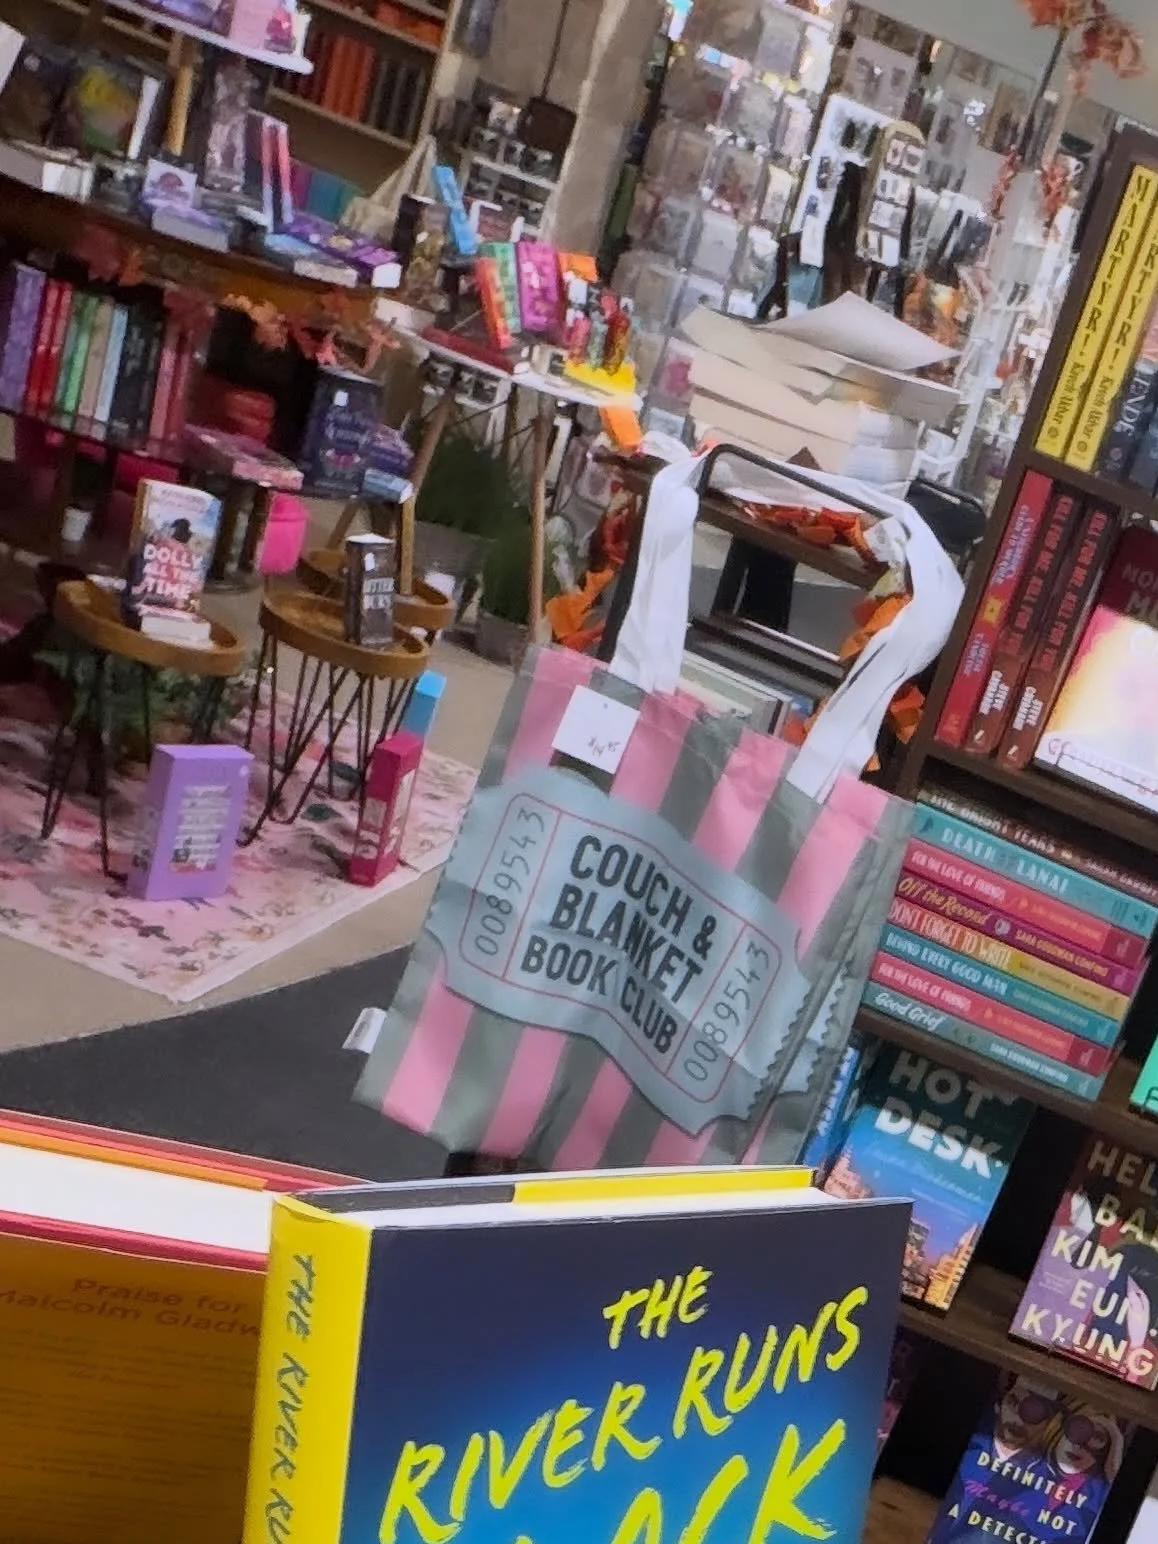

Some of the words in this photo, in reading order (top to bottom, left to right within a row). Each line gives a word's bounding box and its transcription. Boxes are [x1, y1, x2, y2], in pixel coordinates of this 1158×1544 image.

[1076, 176, 1151, 358] MARTYR!
[142, 542, 203, 569] DOLLY
[474, 807, 547, 957] 0089543
[569, 834, 695, 937] COUCH
[691, 914, 719, 961] &
[548, 883, 704, 1004] BLANKET
[519, 934, 618, 997] BOOK
[619, 975, 679, 1055] CLUB
[682, 939, 771, 1082] 0089543
[875, 992, 912, 1022] Good
[909, 1002, 944, 1031] Grief
[889, 1052, 994, 1119] HOT
[875, 1095, 1003, 1179] DESK
[73, 1278, 183, 1306] Praise
[197, 1294, 248, 1315] for
[291, 1251, 318, 1343] THE
[1051, 1228, 1124, 1281] KIM
[602, 1264, 715, 1350] THE
[1020, 1303, 1155, 1376] KYUNG
[671, 1285, 870, 1439] RUNS
[273, 1352, 309, 1489] RIVER
[948, 1503, 960, 1519] A
[976, 1451, 1088, 1509] DEFINITELY
[1037, 1510, 1078, 1536] NOT
